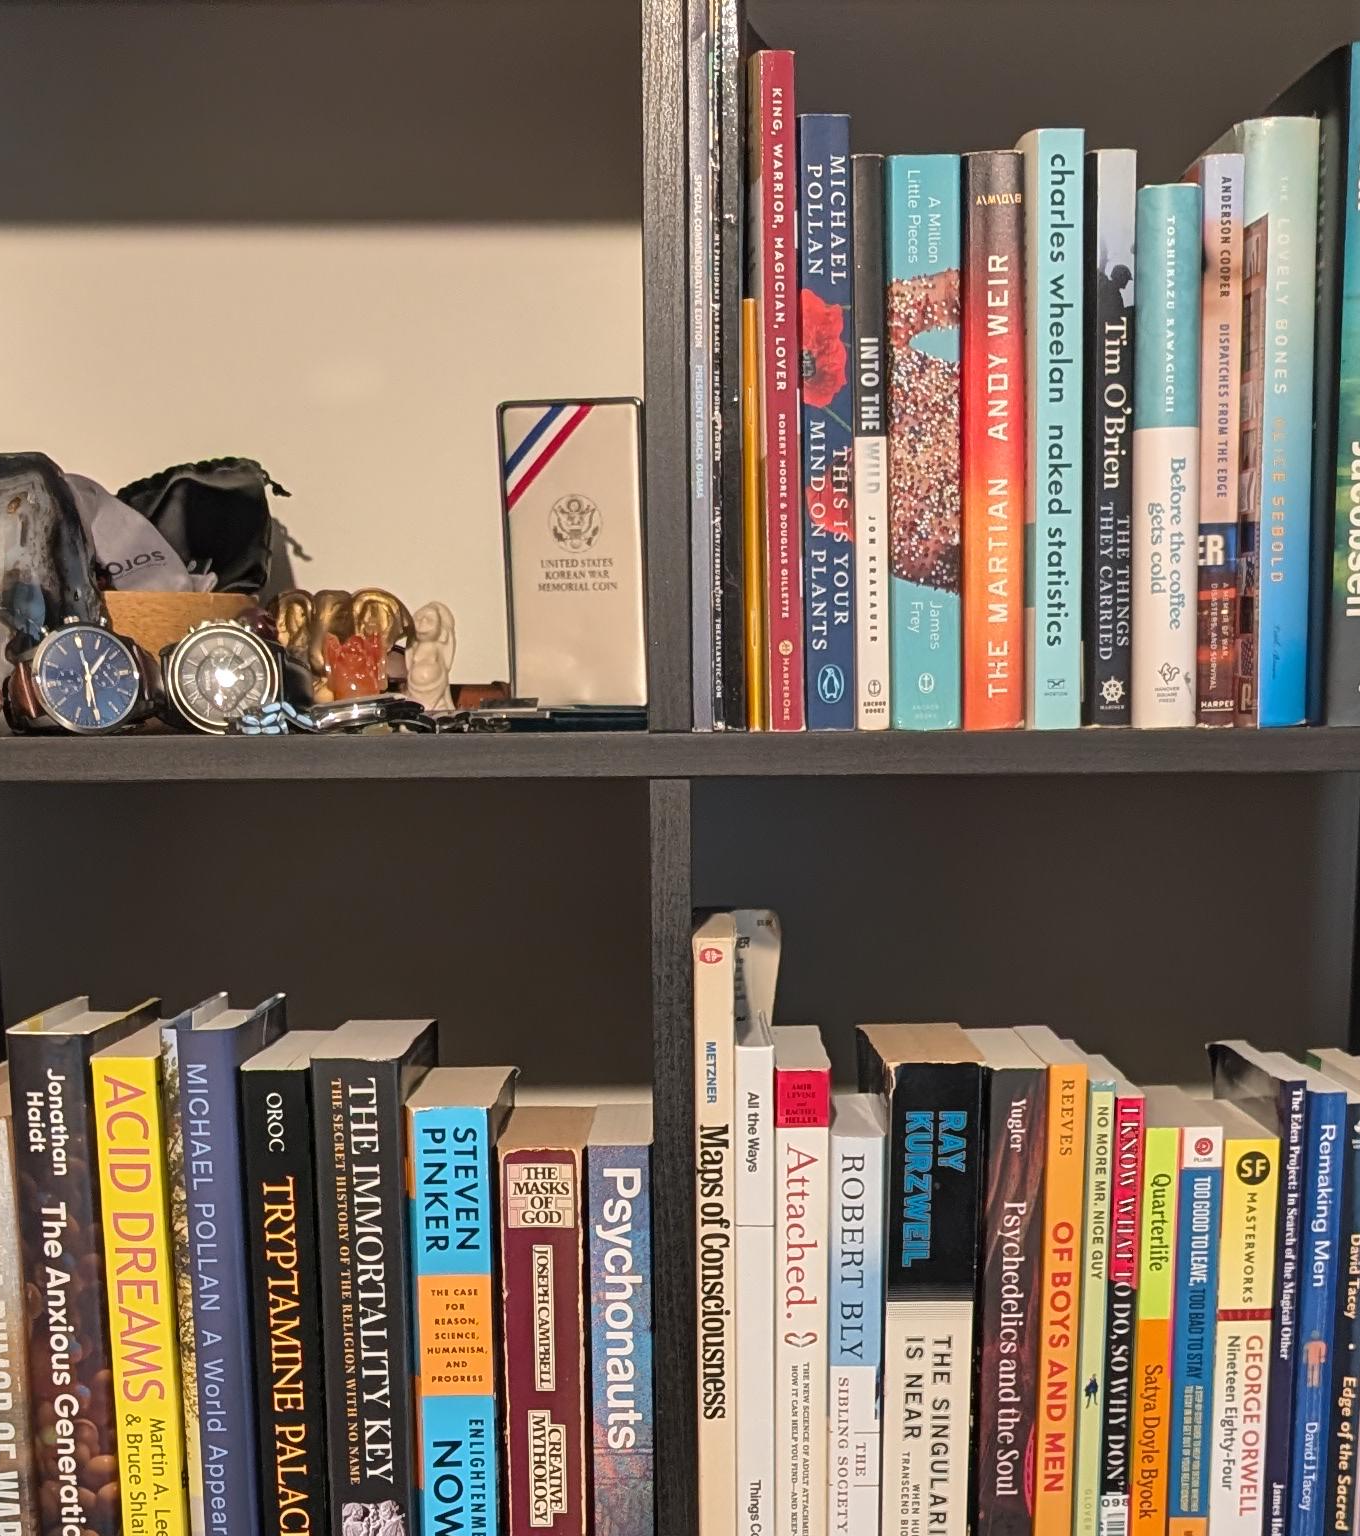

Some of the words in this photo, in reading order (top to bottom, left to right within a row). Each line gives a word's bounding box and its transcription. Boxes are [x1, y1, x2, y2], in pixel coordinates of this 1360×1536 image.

[1050, 153, 1075, 263] charles
[988, 254, 1009, 337] WEIR
[1049, 275, 1074, 404] wheelan
[988, 354, 1009, 439] ANDY
[1048, 425, 1073, 517] naked
[538, 582, 590, 592] MEMORIAL
[594, 581, 618, 591] COIN
[541, 560, 577, 569] UNITED
[579, 558, 615, 568] STATES
[545, 572, 584, 580] KOREAN
[588, 571, 610, 580] WAR
[986, 478, 1009, 621] MARTIAN
[1048, 526, 1073, 647] statistics
[986, 641, 1008, 697] THE
[705, 1041, 718, 1105] METZNER
[103, 1075, 152, 1194] ACID
[938, 1111, 966, 1173] RAY
[39, 1202, 64, 1258] The
[421, 1128, 448, 1253] PINKER
[451, 1128, 479, 1252] STEVEN
[900, 1111, 934, 1268] KURZWEIL
[1149, 1173, 1172, 1273] Quarterlife
[1052, 1221, 1073, 1261] OF
[43, 1264, 71, 1385] Anxious
[111, 1212, 166, 1403] DREAMS
[263, 1177, 305, 1412] TRYPTAMINE
[434, 1317, 479, 1326] REASON,
[601, 1167, 642, 1450] Psychonauts
[1048, 1273, 1072, 1351] BOYS
[431, 1374, 483, 1383] PROGRESS
[1046, 1363, 1069, 1423] AND
[1045, 1430, 1066, 1493] MEN
